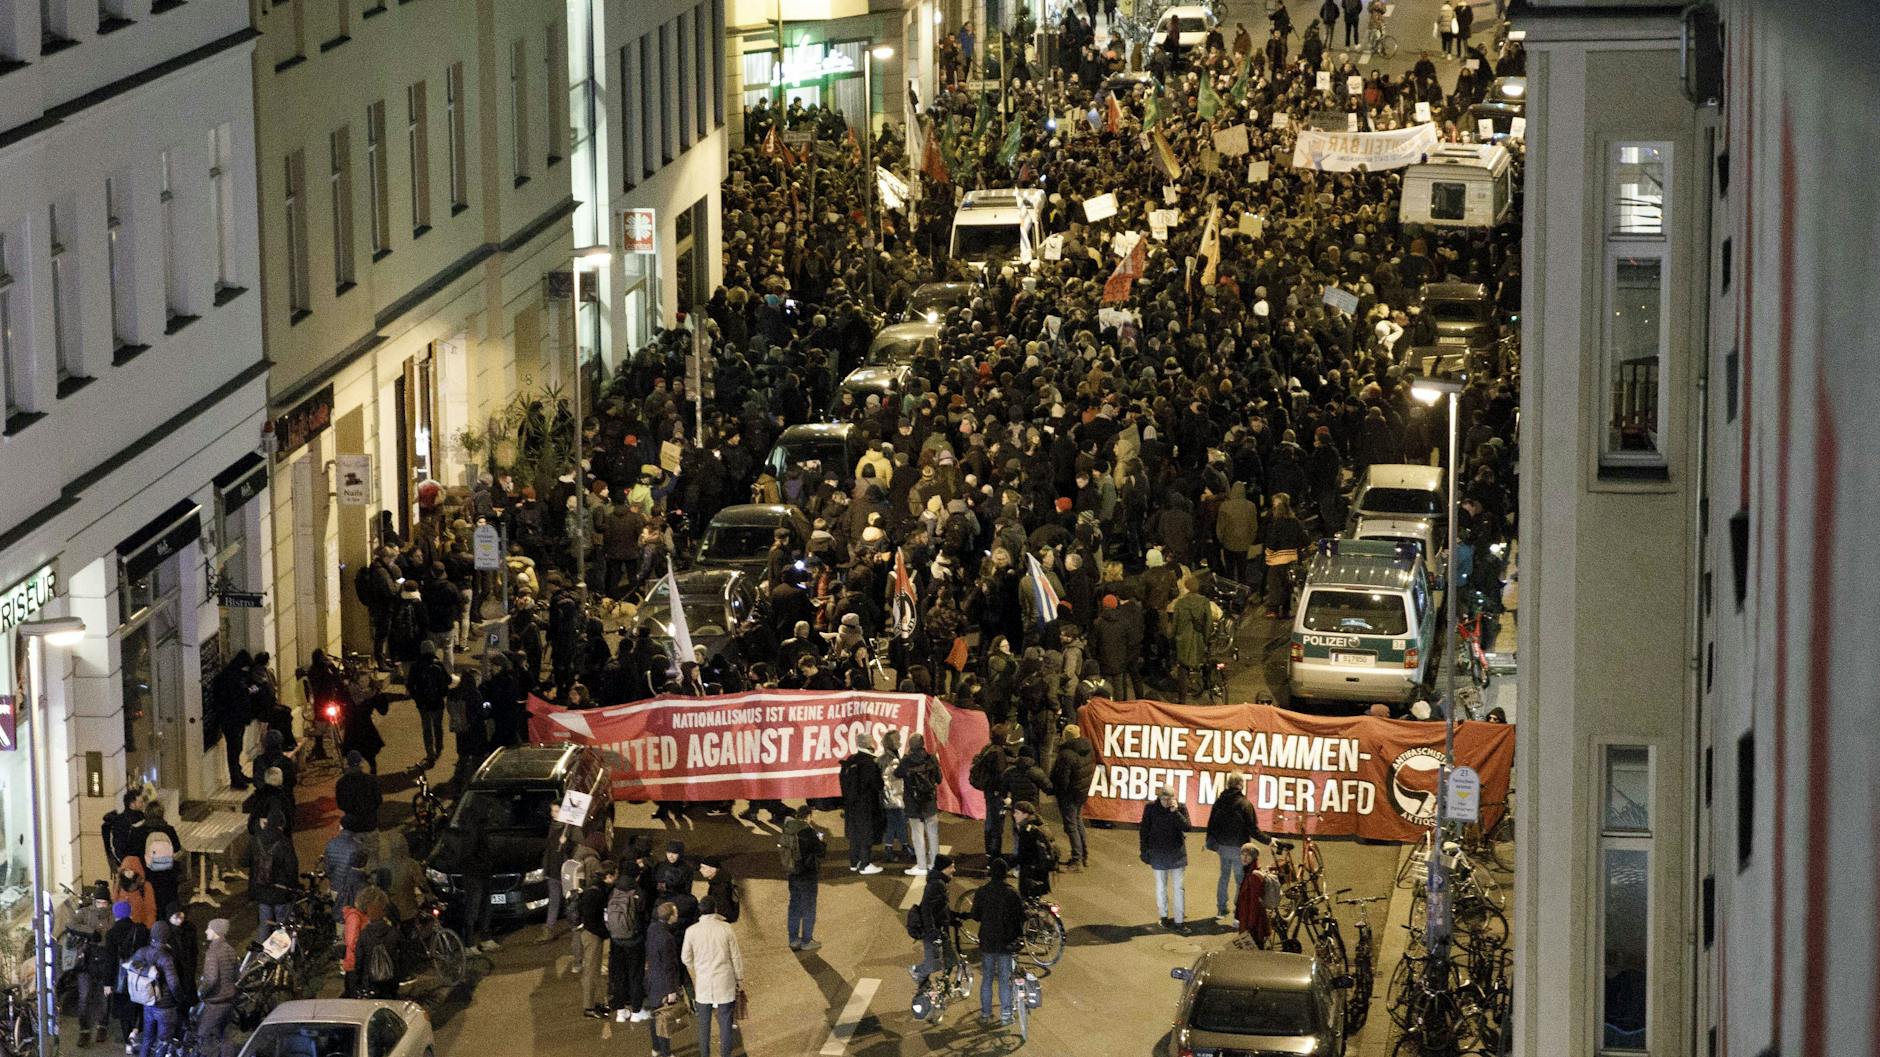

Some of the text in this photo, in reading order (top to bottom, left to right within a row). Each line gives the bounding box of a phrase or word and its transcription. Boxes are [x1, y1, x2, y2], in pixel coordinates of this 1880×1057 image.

[225, 597, 255, 607] Bistro
[1303, 635, 1346, 646] POLIZEI
[672, 701, 902, 729] NATIONALISMUS IST KEINE ALTERNATIVE
[587, 735, 678, 772] NITED
[687, 725, 794, 769] AGAINST
[1104, 724, 1372, 773] KEINE ZUSAMMEN-
[1198, 770, 1253, 805] MT
[1258, 773, 1316, 813] DER
[1321, 778, 1376, 816] AFD
